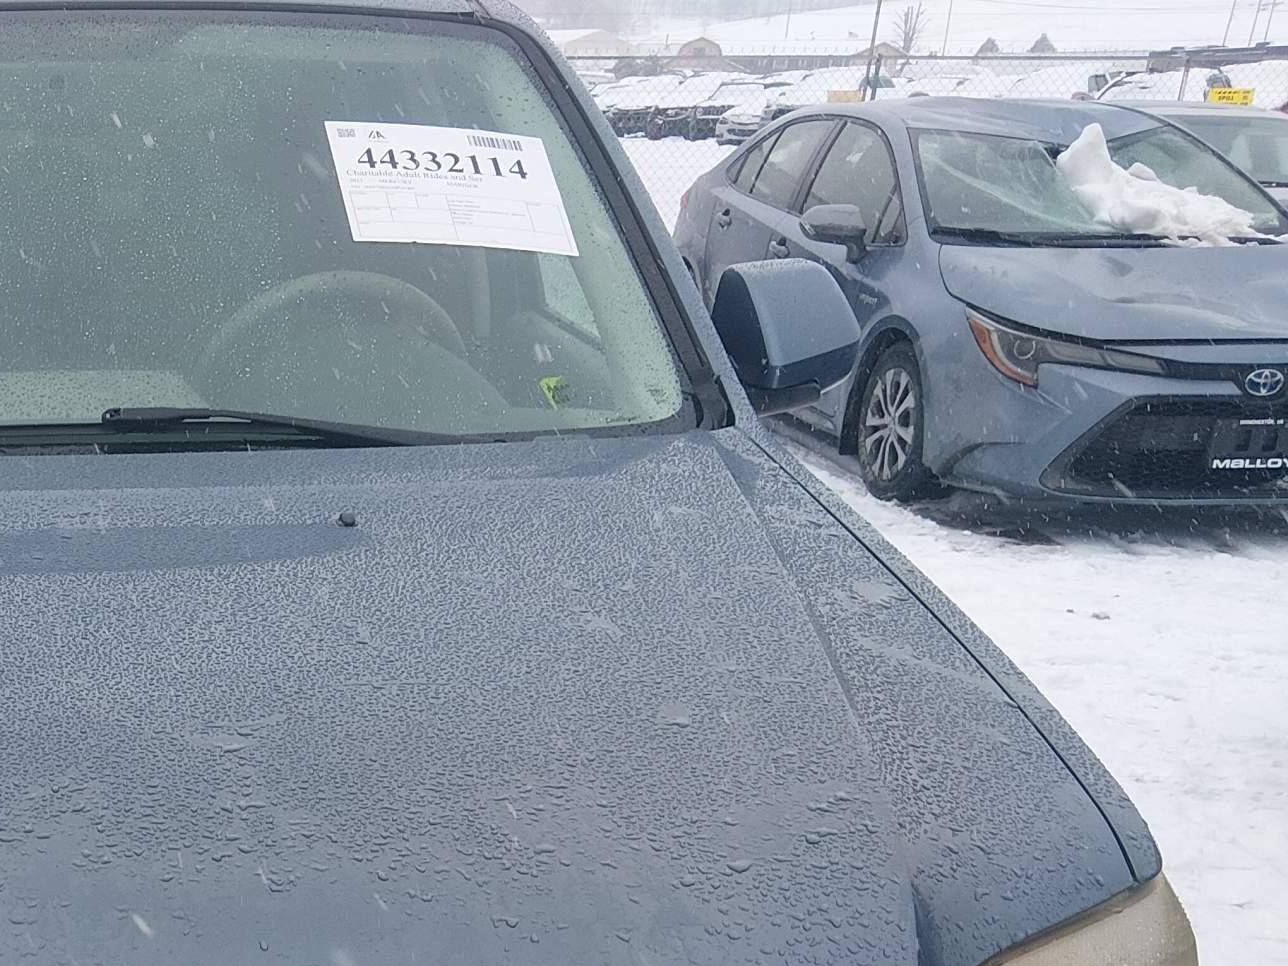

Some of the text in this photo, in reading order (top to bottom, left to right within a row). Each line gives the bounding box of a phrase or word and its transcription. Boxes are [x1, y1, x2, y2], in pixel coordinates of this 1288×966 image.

[357, 147, 528, 179] 44332114
[346, 169, 393, 177] Charitable
[396, 170, 421, 179] Adult
[423, 172, 449, 180] Rides
